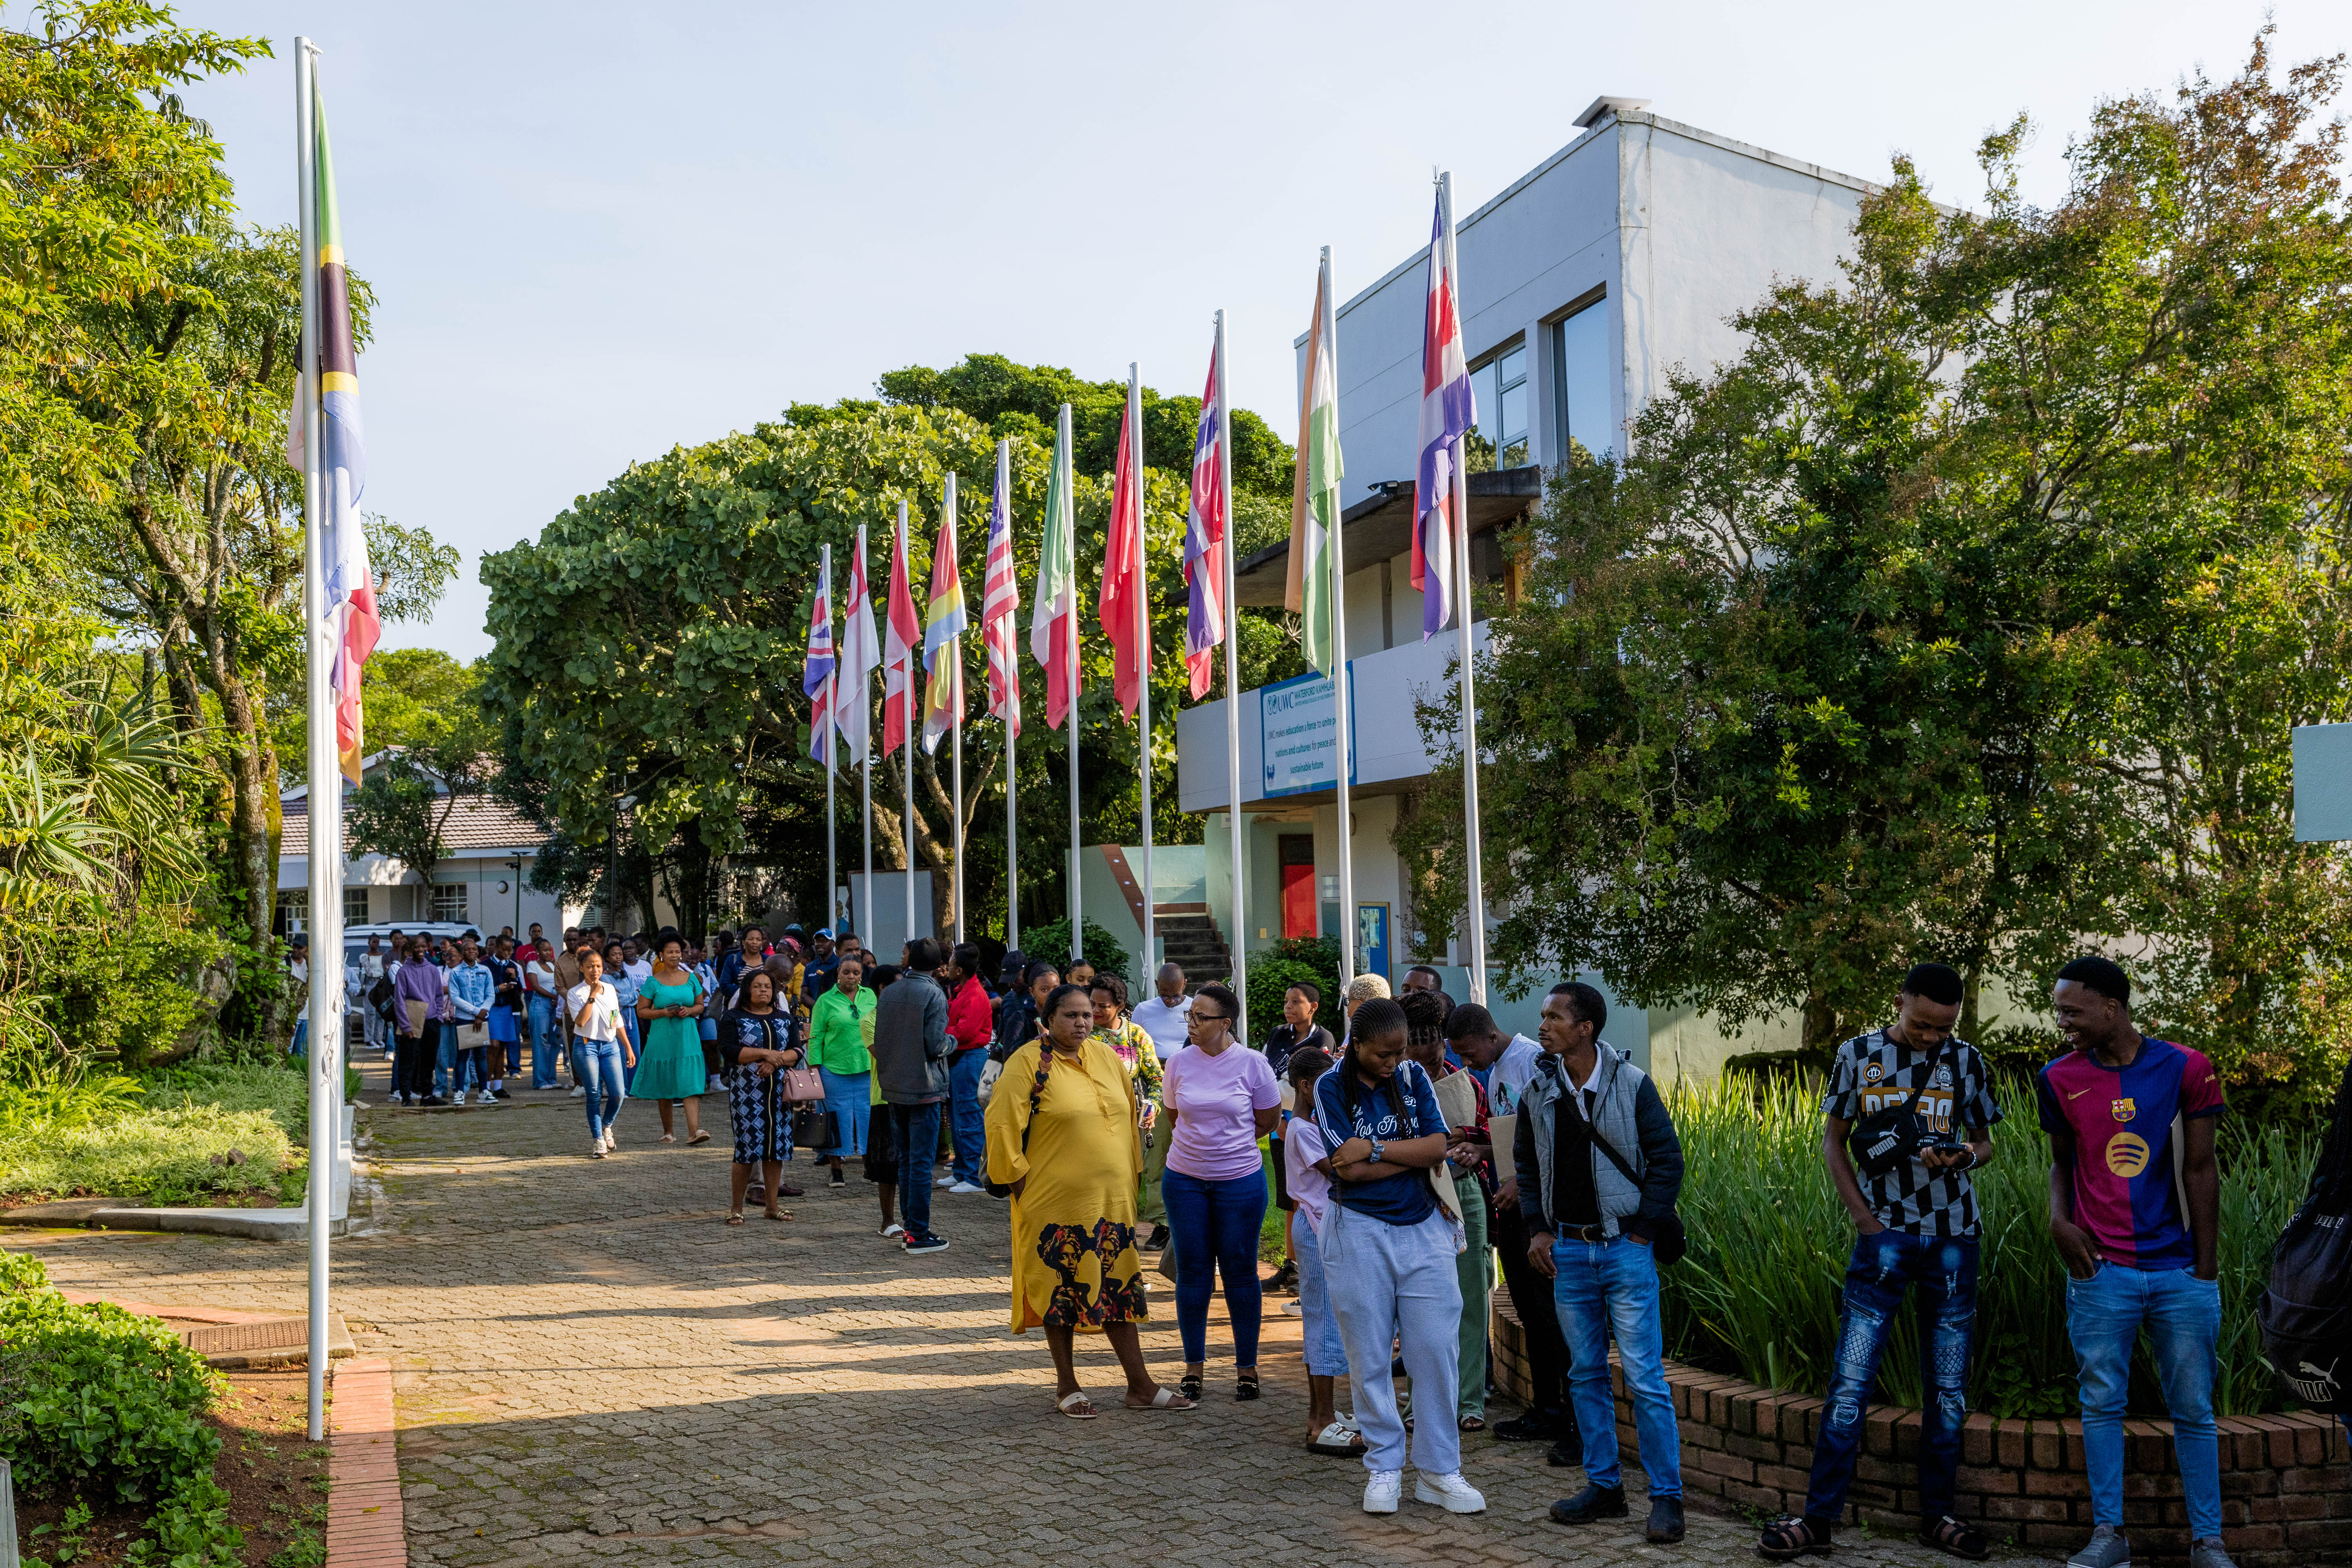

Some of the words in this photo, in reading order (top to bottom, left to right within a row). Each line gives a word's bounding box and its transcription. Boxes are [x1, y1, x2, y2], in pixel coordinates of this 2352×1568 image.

[1294, 686, 1316, 700] WATERFORD
[1316, 681, 1335, 694] KAMHLAB
[1278, 691, 1294, 711] UWC
[1276, 728, 1286, 738] makes
[1286, 724, 1304, 735] education
[1307, 721, 1316, 730] force
[1317, 720, 1321, 728] to
[1322, 717, 1332, 727] unite
[1275, 748, 1288, 758] nations
[1296, 743, 1311, 753] cultures
[1317, 740, 1329, 751] peace
[1290, 762, 1311, 774] sustainable
[1312, 760, 1324, 771] future
[2205, 1074, 2215, 1083] AMB
[1867, 1136, 1897, 1159] PUMA
